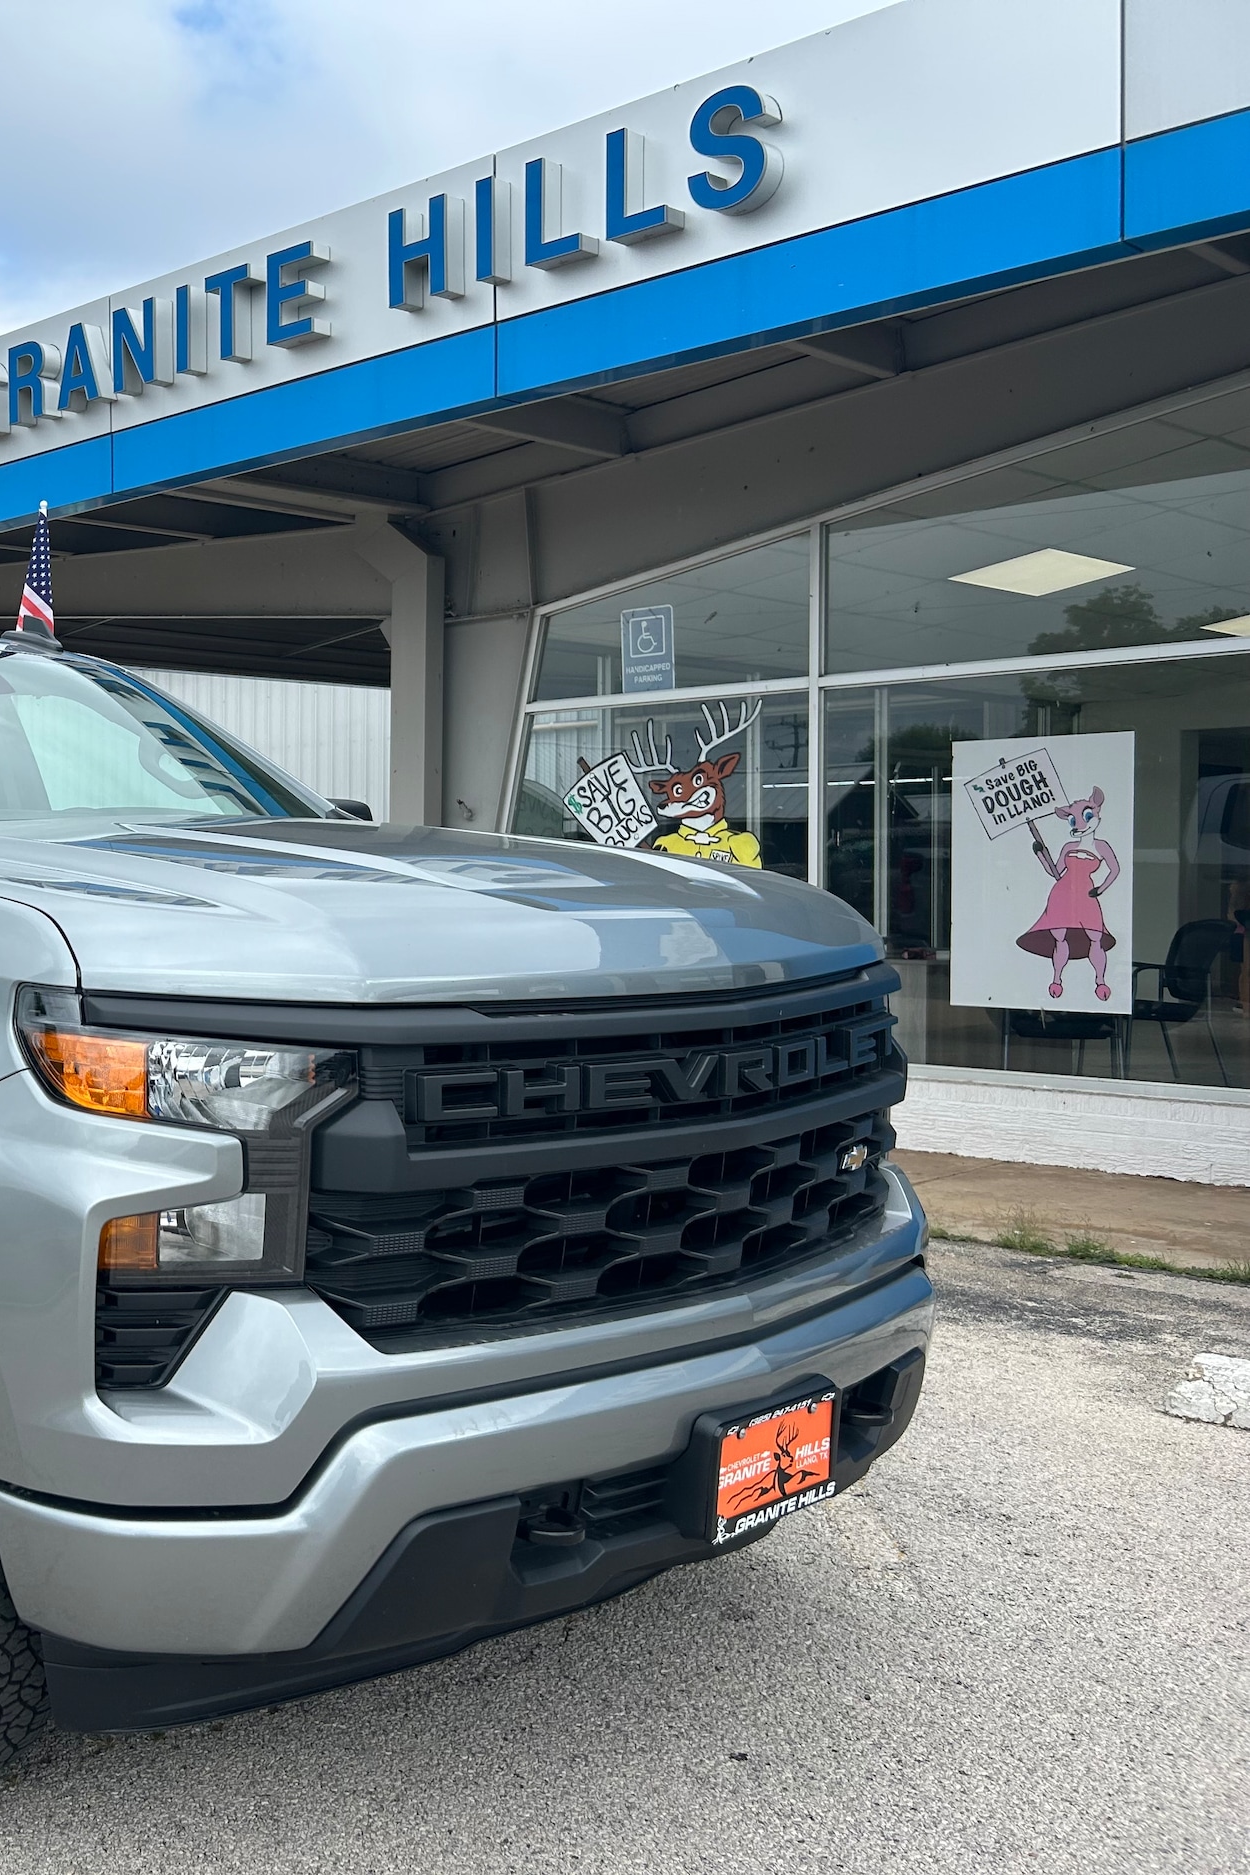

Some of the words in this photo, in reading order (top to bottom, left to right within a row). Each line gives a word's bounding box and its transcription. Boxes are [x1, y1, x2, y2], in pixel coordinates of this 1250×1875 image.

[387, 84, 784, 312] HILLS
[625, 662, 671, 675] HANDICAPPED
[634, 673, 663, 684] PARKING
[577, 759, 628, 808] SAVE
[981, 770, 1050, 815] DOUGH
[985, 771, 1016, 791] Save
[1015, 759, 1038, 778] BIG
[586, 786, 636, 834] BIG
[992, 812, 1007, 825] in
[1008, 790, 1056, 819] LLANO!
[406, 1014, 899, 1123] CHEVROLET
[718, 1458, 772, 1490] GRANITE
[794, 1437, 831, 1460] HILLS
[726, 1454, 761, 1472] CHEVROLET
[819, 1451, 829, 1461] TX
[734, 1496, 798, 1535] GRANITE
[797, 1481, 836, 1509] HILLS
